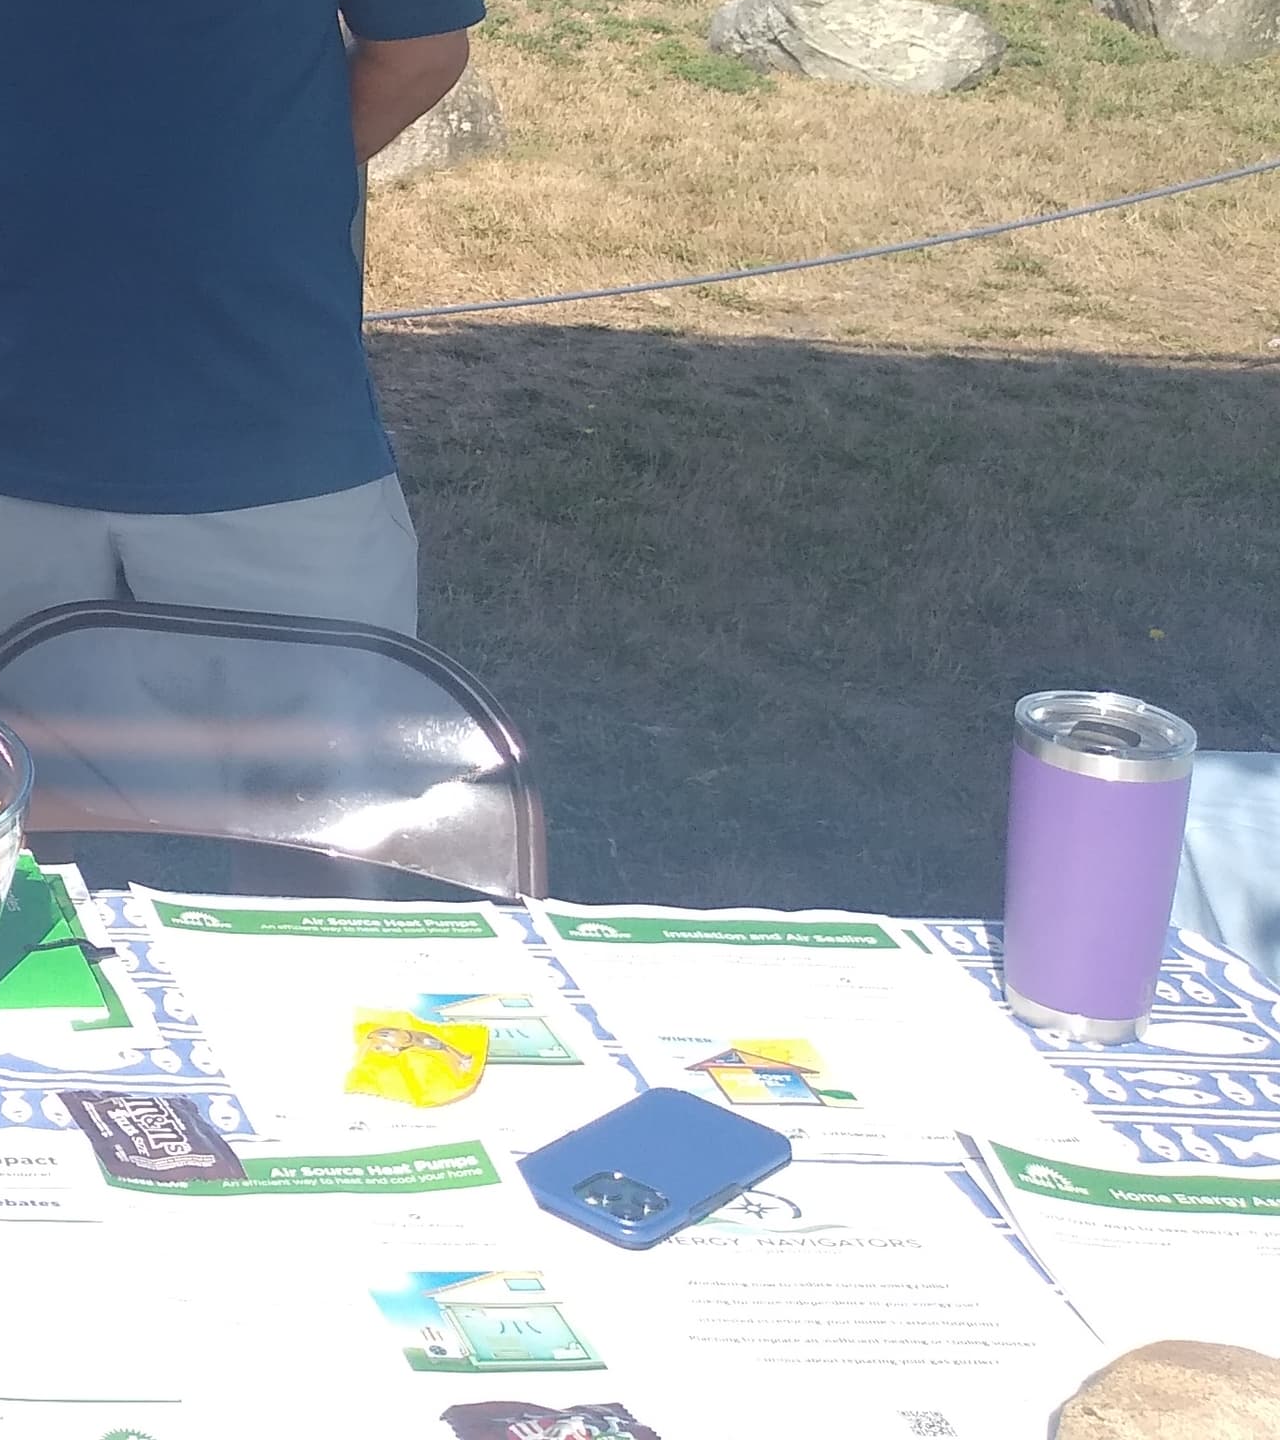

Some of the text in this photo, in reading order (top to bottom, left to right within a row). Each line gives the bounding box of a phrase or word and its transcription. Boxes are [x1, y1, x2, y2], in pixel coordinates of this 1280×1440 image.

[301, 917, 478, 929] Air Source Heat Pumps
[662, 929, 878, 946] Insulation and Air Sealing
[657, 1035, 713, 1045] WINTER
[270, 1154, 479, 1178] Air Source Heat Pumps
[221, 1167, 483, 1188] An efficient way to heat and cool your home
[1108, 1188, 1172, 1205] Home
[1175, 1193, 1247, 1209] Energy
[756, 1237, 924, 1250] NAVIGATORS
